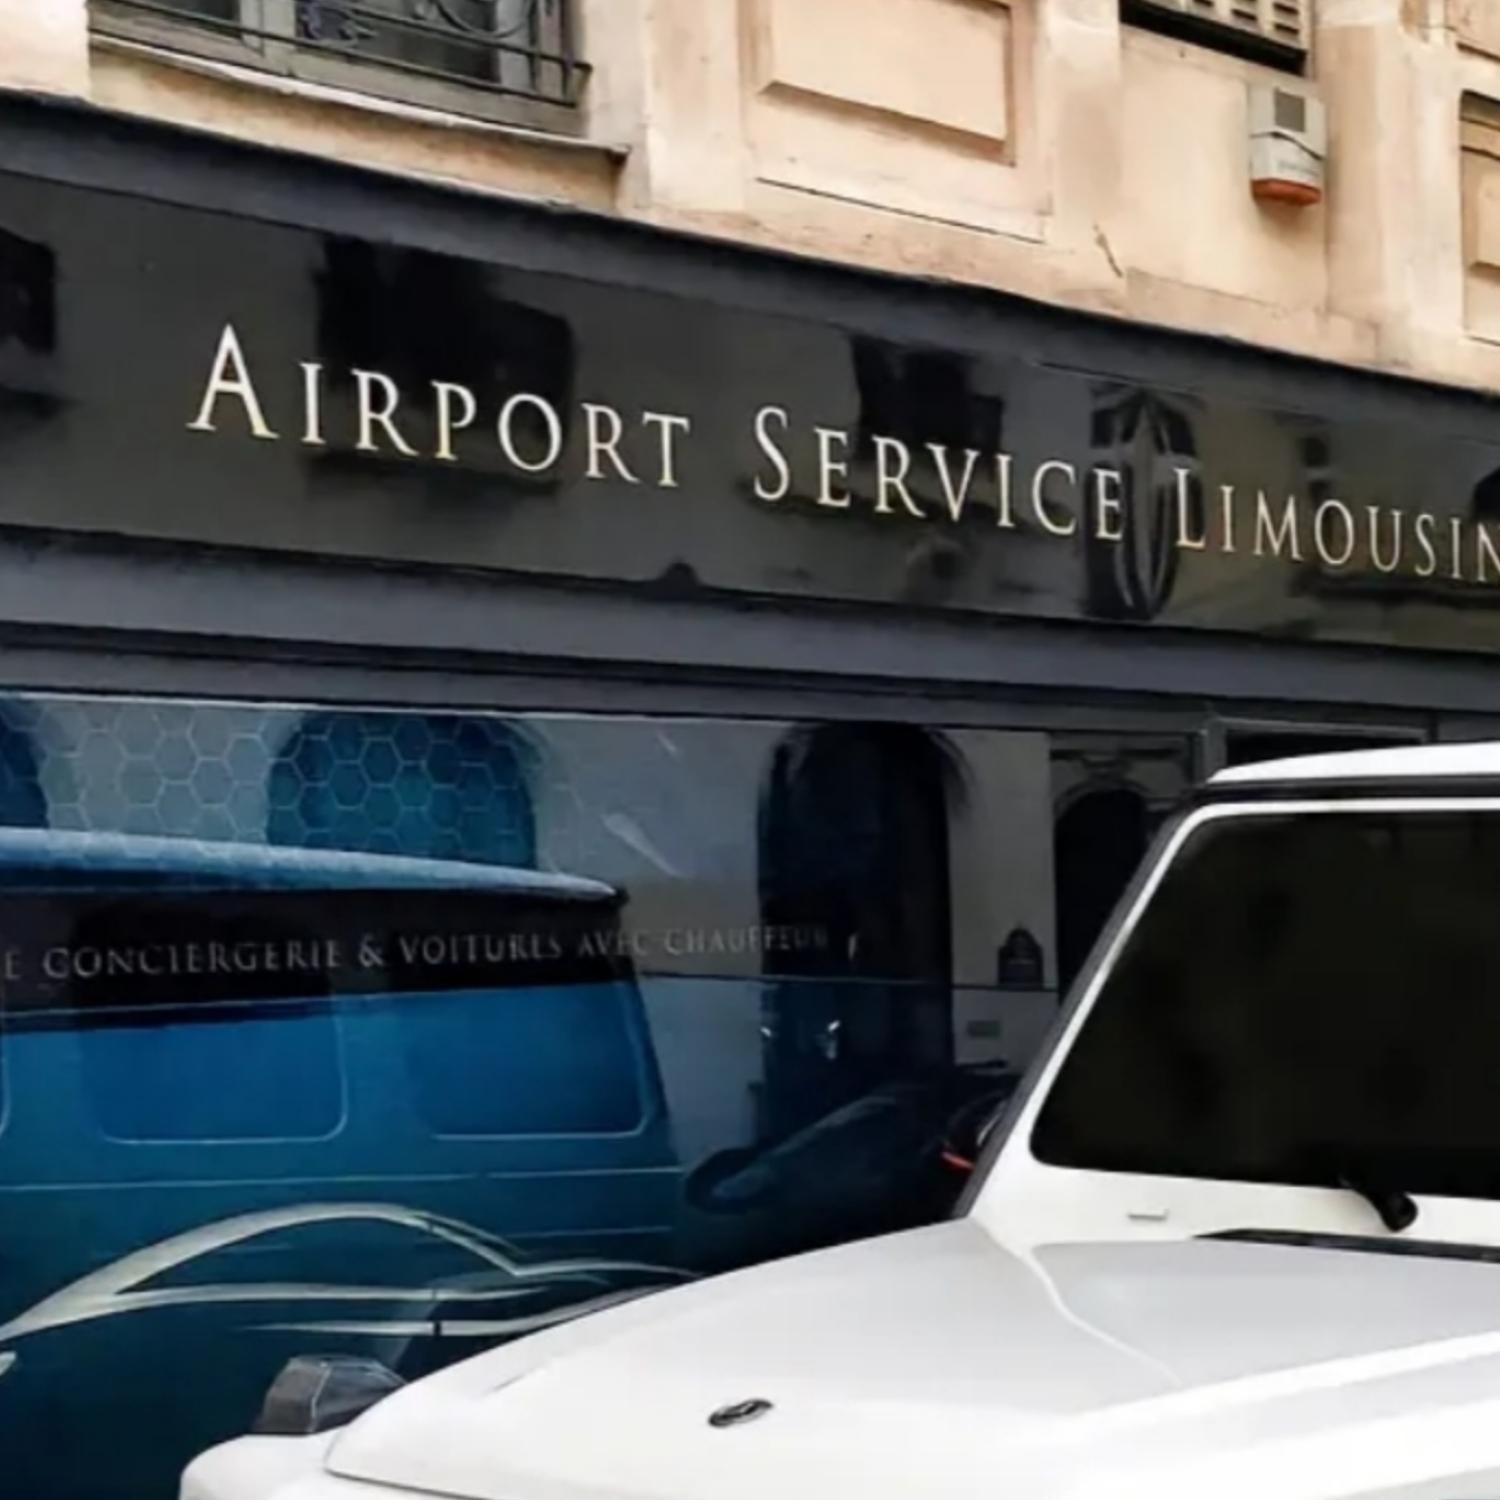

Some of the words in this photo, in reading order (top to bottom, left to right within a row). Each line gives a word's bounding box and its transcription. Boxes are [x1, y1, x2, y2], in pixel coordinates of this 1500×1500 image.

[187, 323, 690, 487] AIRPORT
[754, 407, 1123, 538] SERVICE
[42, 938, 340, 979] CONCIERGERIE
[358, 934, 384, 967] &
